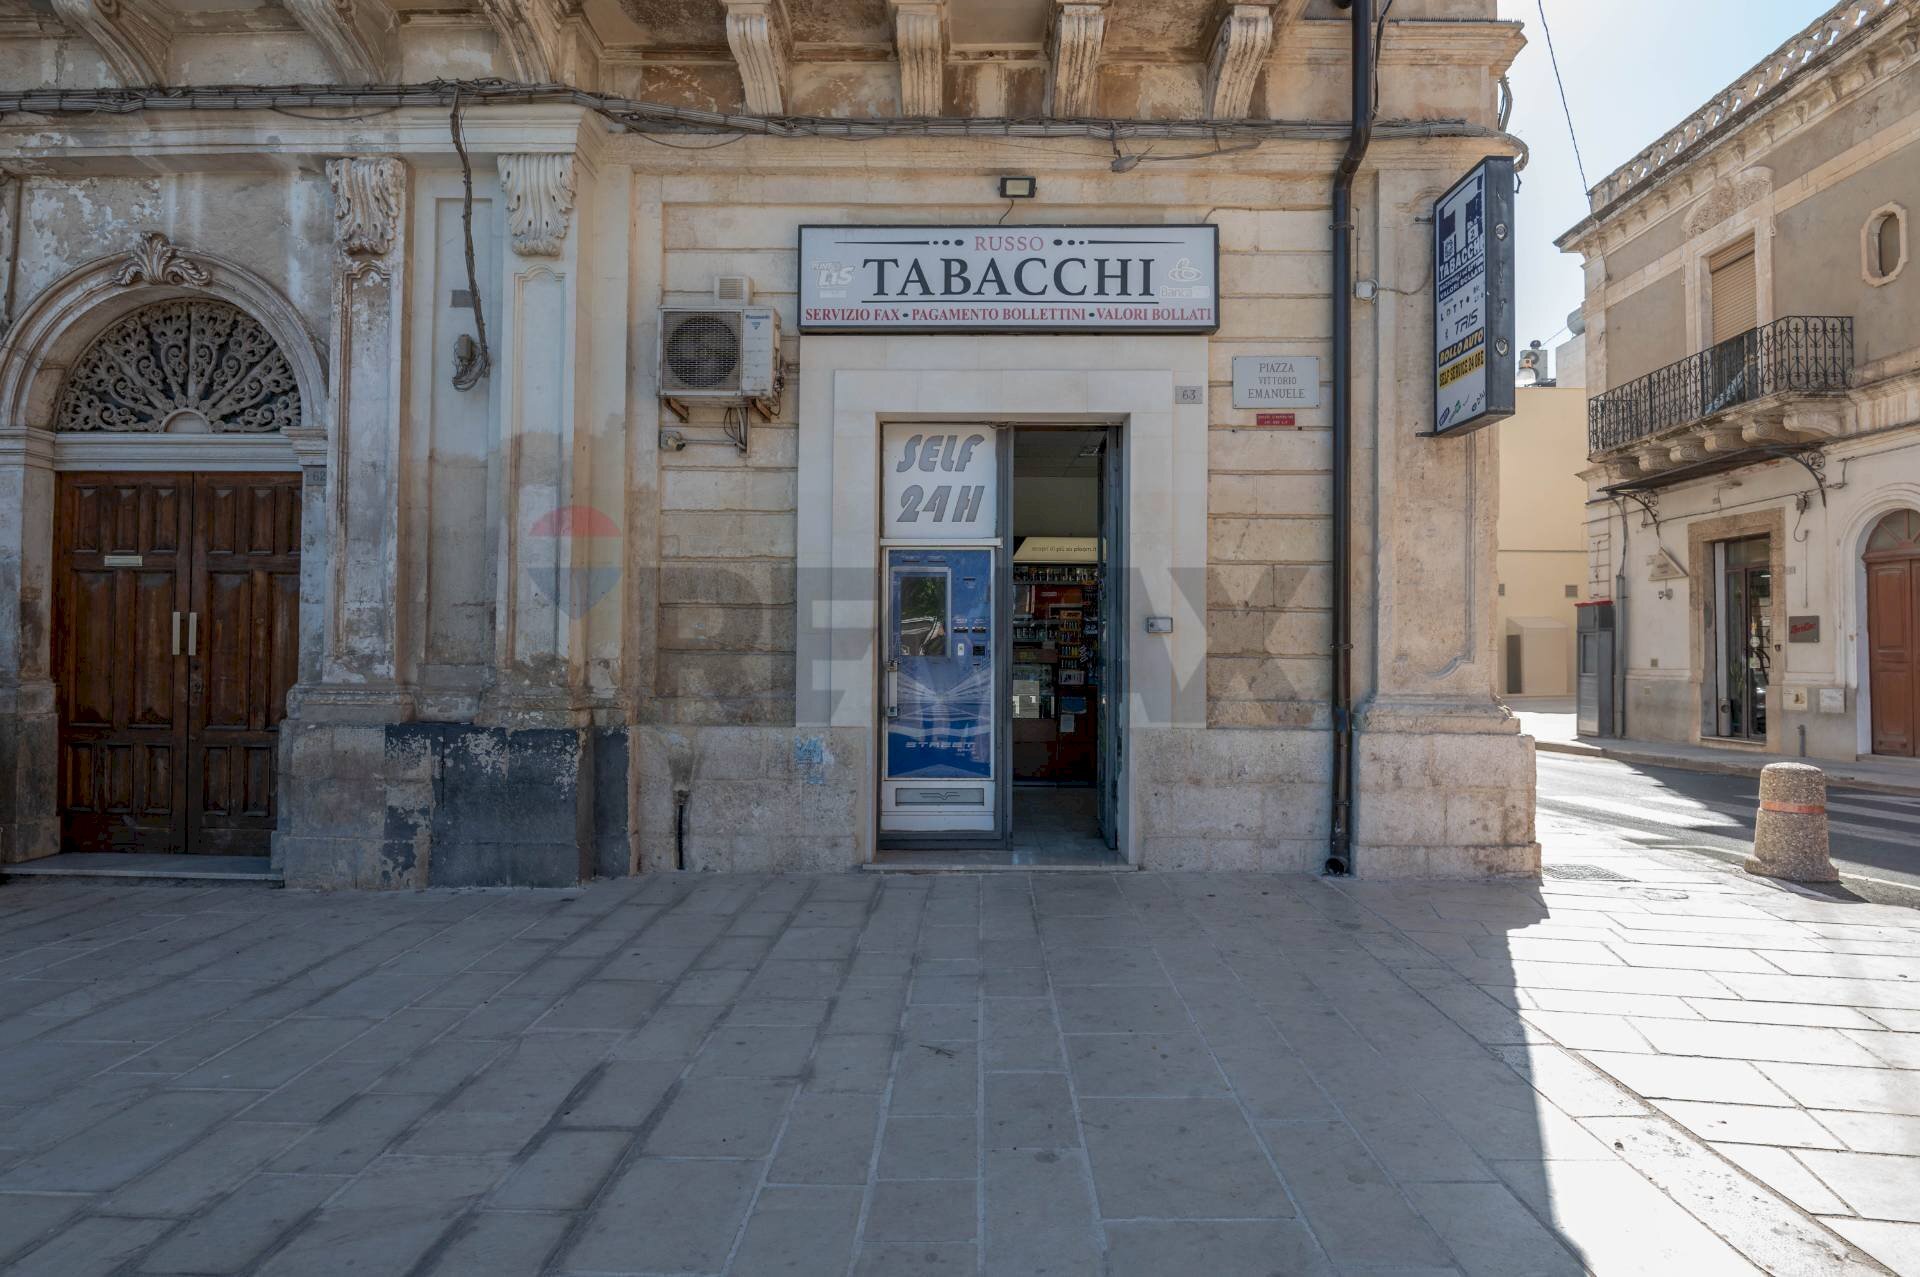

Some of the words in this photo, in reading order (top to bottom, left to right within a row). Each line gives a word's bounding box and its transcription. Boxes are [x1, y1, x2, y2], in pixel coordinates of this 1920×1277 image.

[975, 236, 1044, 251] RUSSO
[862, 257, 1155, 297] TABACCHI
[805, 308, 870, 321] SERVIZIO
[874, 308, 900, 321] FAX
[911, 308, 999, 321] PAGAMENTO
[1002, 308, 1086, 321] BOLLETTINI
[1096, 308, 1148, 321] VALORI
[1152, 308, 1211, 321] BOLLATI
[1455, 308, 1478, 335] TRIS
[1440, 341, 1462, 364] BOLLO
[1463, 328, 1484, 350] AUTO
[1259, 362, 1294, 373] PIAZZA
[1258, 376, 1297, 385] VITTORIO
[1182, 389, 1196, 401] 63
[1248, 388, 1305, 399] EMANUELE
[896, 434, 985, 473] SELF
